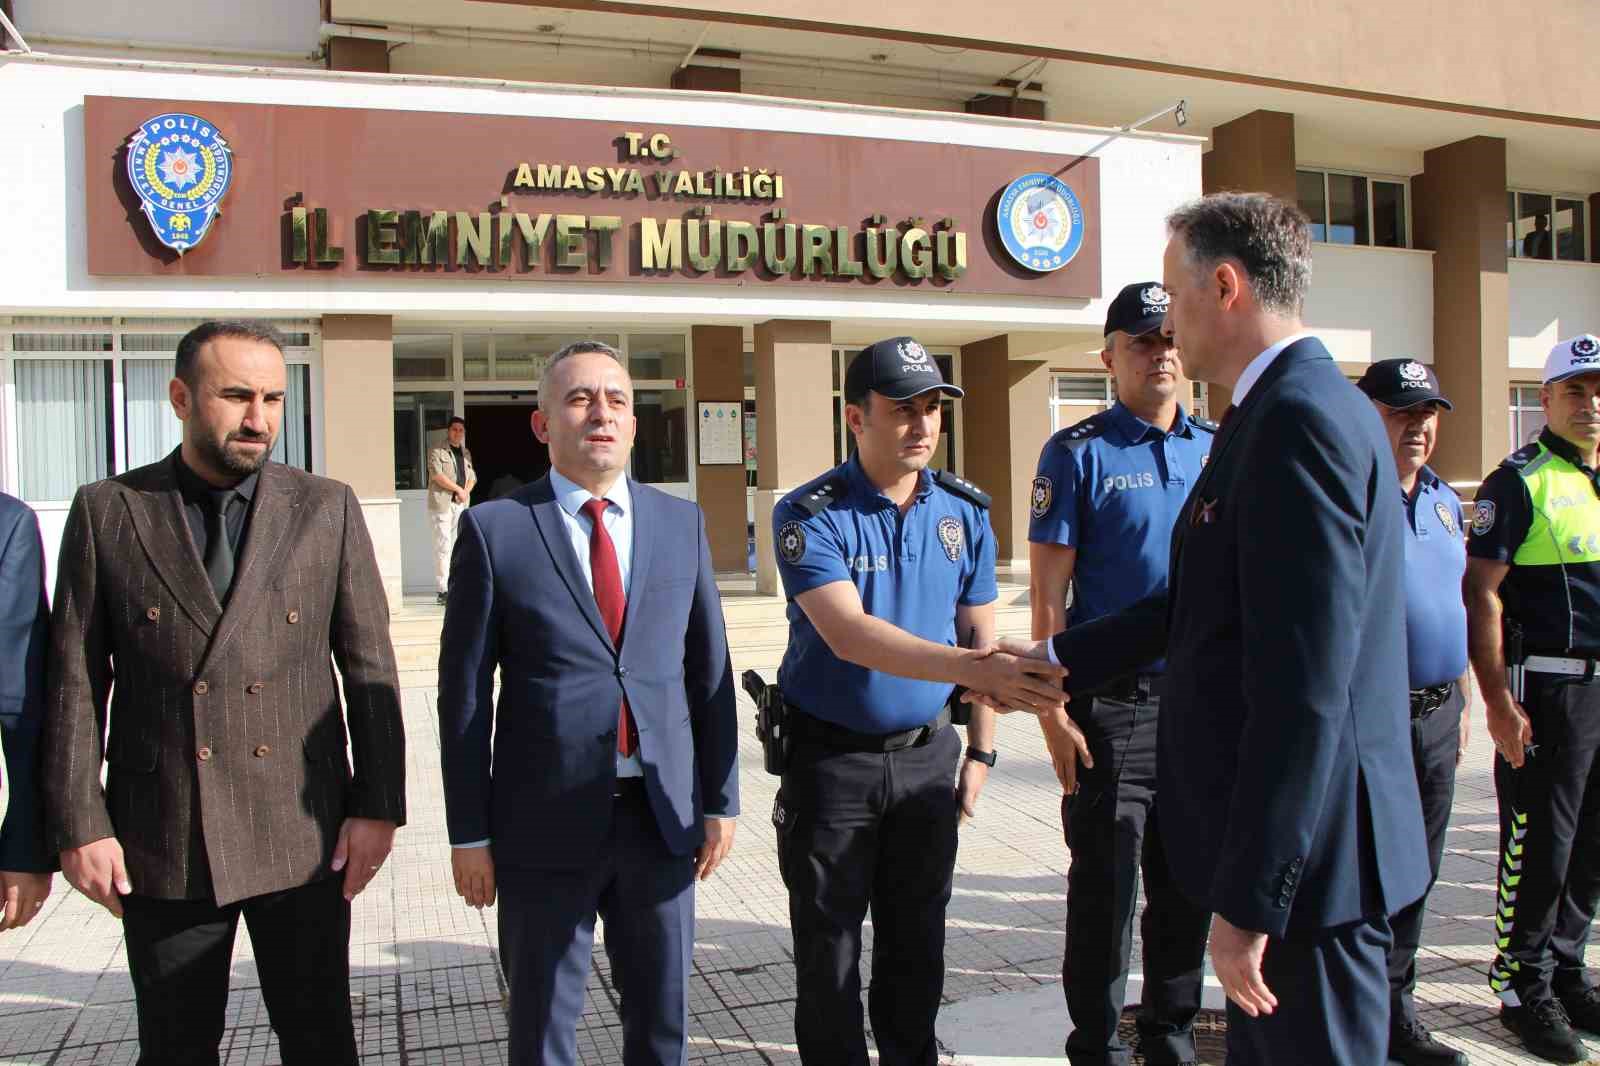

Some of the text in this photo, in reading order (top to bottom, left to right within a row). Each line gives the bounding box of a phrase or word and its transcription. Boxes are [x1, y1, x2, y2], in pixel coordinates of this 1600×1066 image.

[513, 163, 646, 193] AMASYA
[367, 195, 623, 267] EMNİYET
[641, 205, 967, 280] MÜDÜRLÜĞÜ
